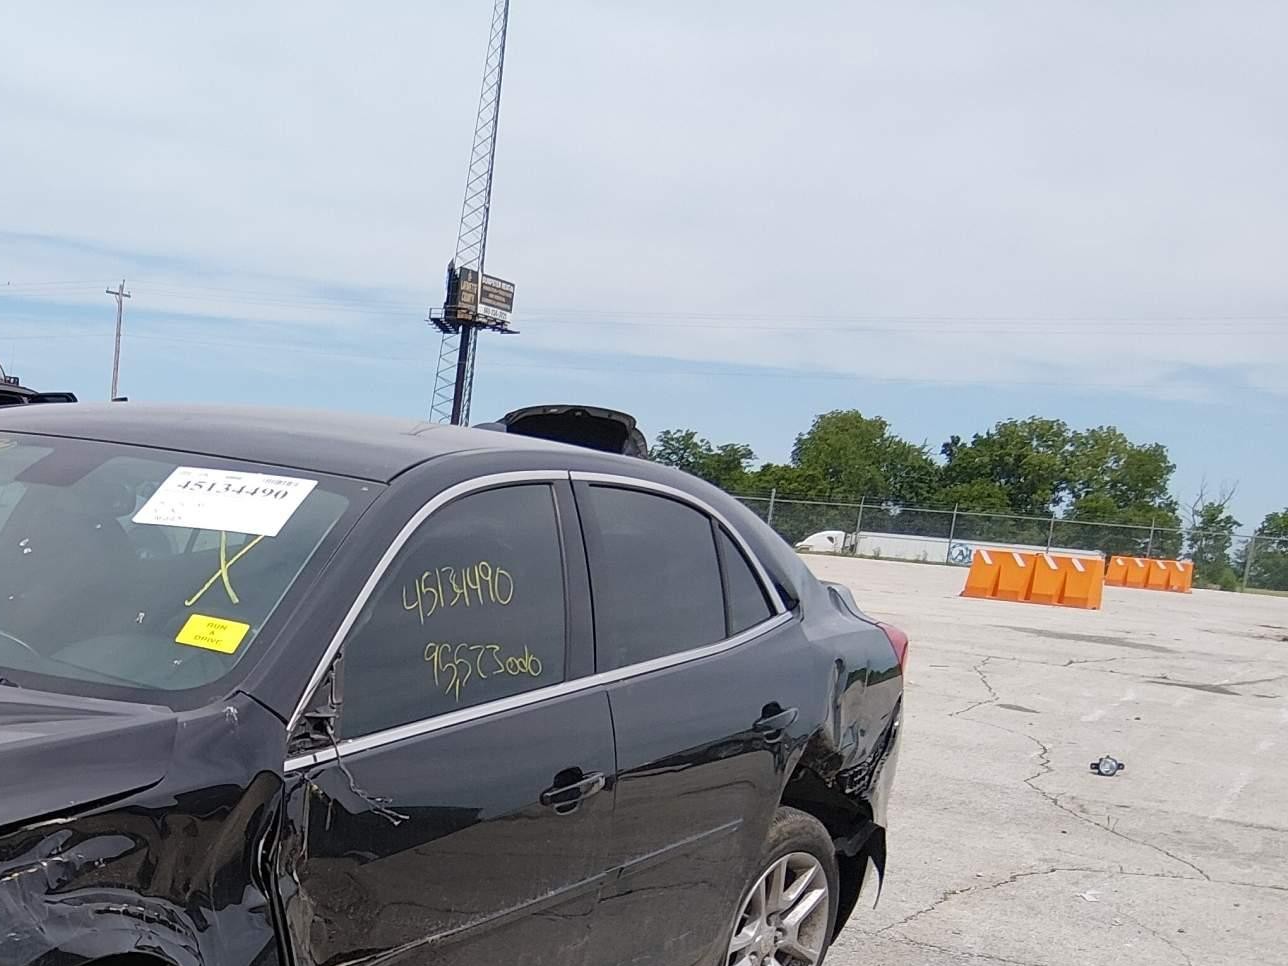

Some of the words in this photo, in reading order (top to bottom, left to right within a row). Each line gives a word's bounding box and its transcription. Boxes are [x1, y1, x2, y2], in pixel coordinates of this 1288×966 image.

[178, 480, 289, 501] 45134490
[402, 561, 514, 625] 45134490
[206, 622, 228, 631] RUN
[193, 634, 224, 646] DRIVE
